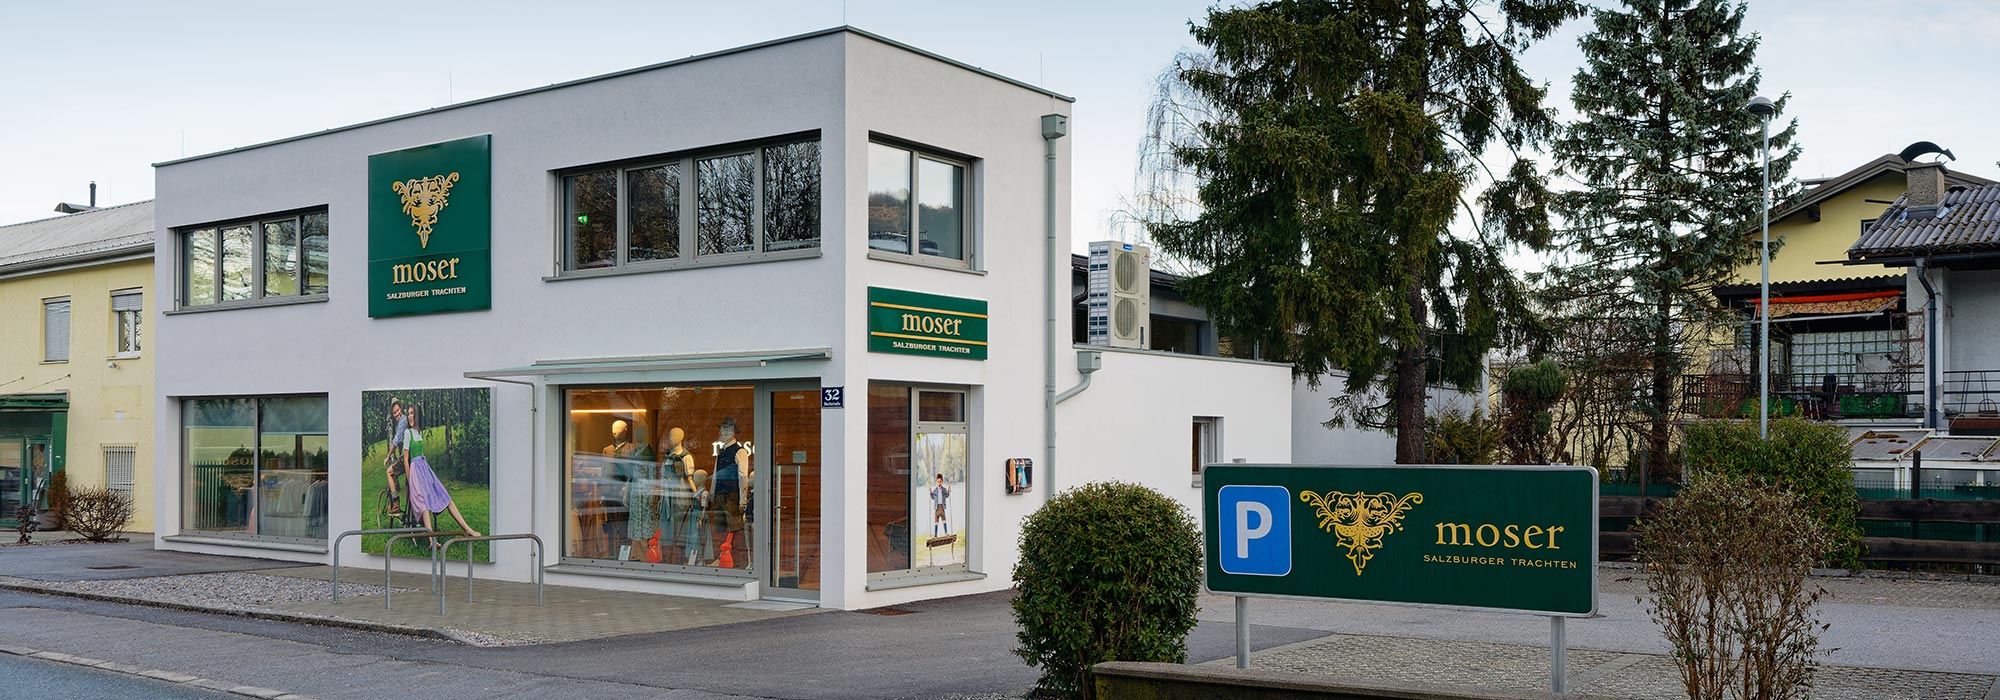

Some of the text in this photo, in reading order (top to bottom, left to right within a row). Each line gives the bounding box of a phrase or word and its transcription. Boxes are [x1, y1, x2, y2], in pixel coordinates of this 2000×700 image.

[392, 257, 459, 284] moser
[386, 286, 466, 300] SALZBURGER TRACHTEN
[902, 313, 962, 336] moser
[892, 341, 970, 353] SALZBURGER TRACHTEN
[824, 388, 840, 401] 32
[1236, 501, 1273, 559] P
[1434, 521, 1565, 550] moser
[1423, 554, 1577, 569] SALZBURGER TRACHTEN
